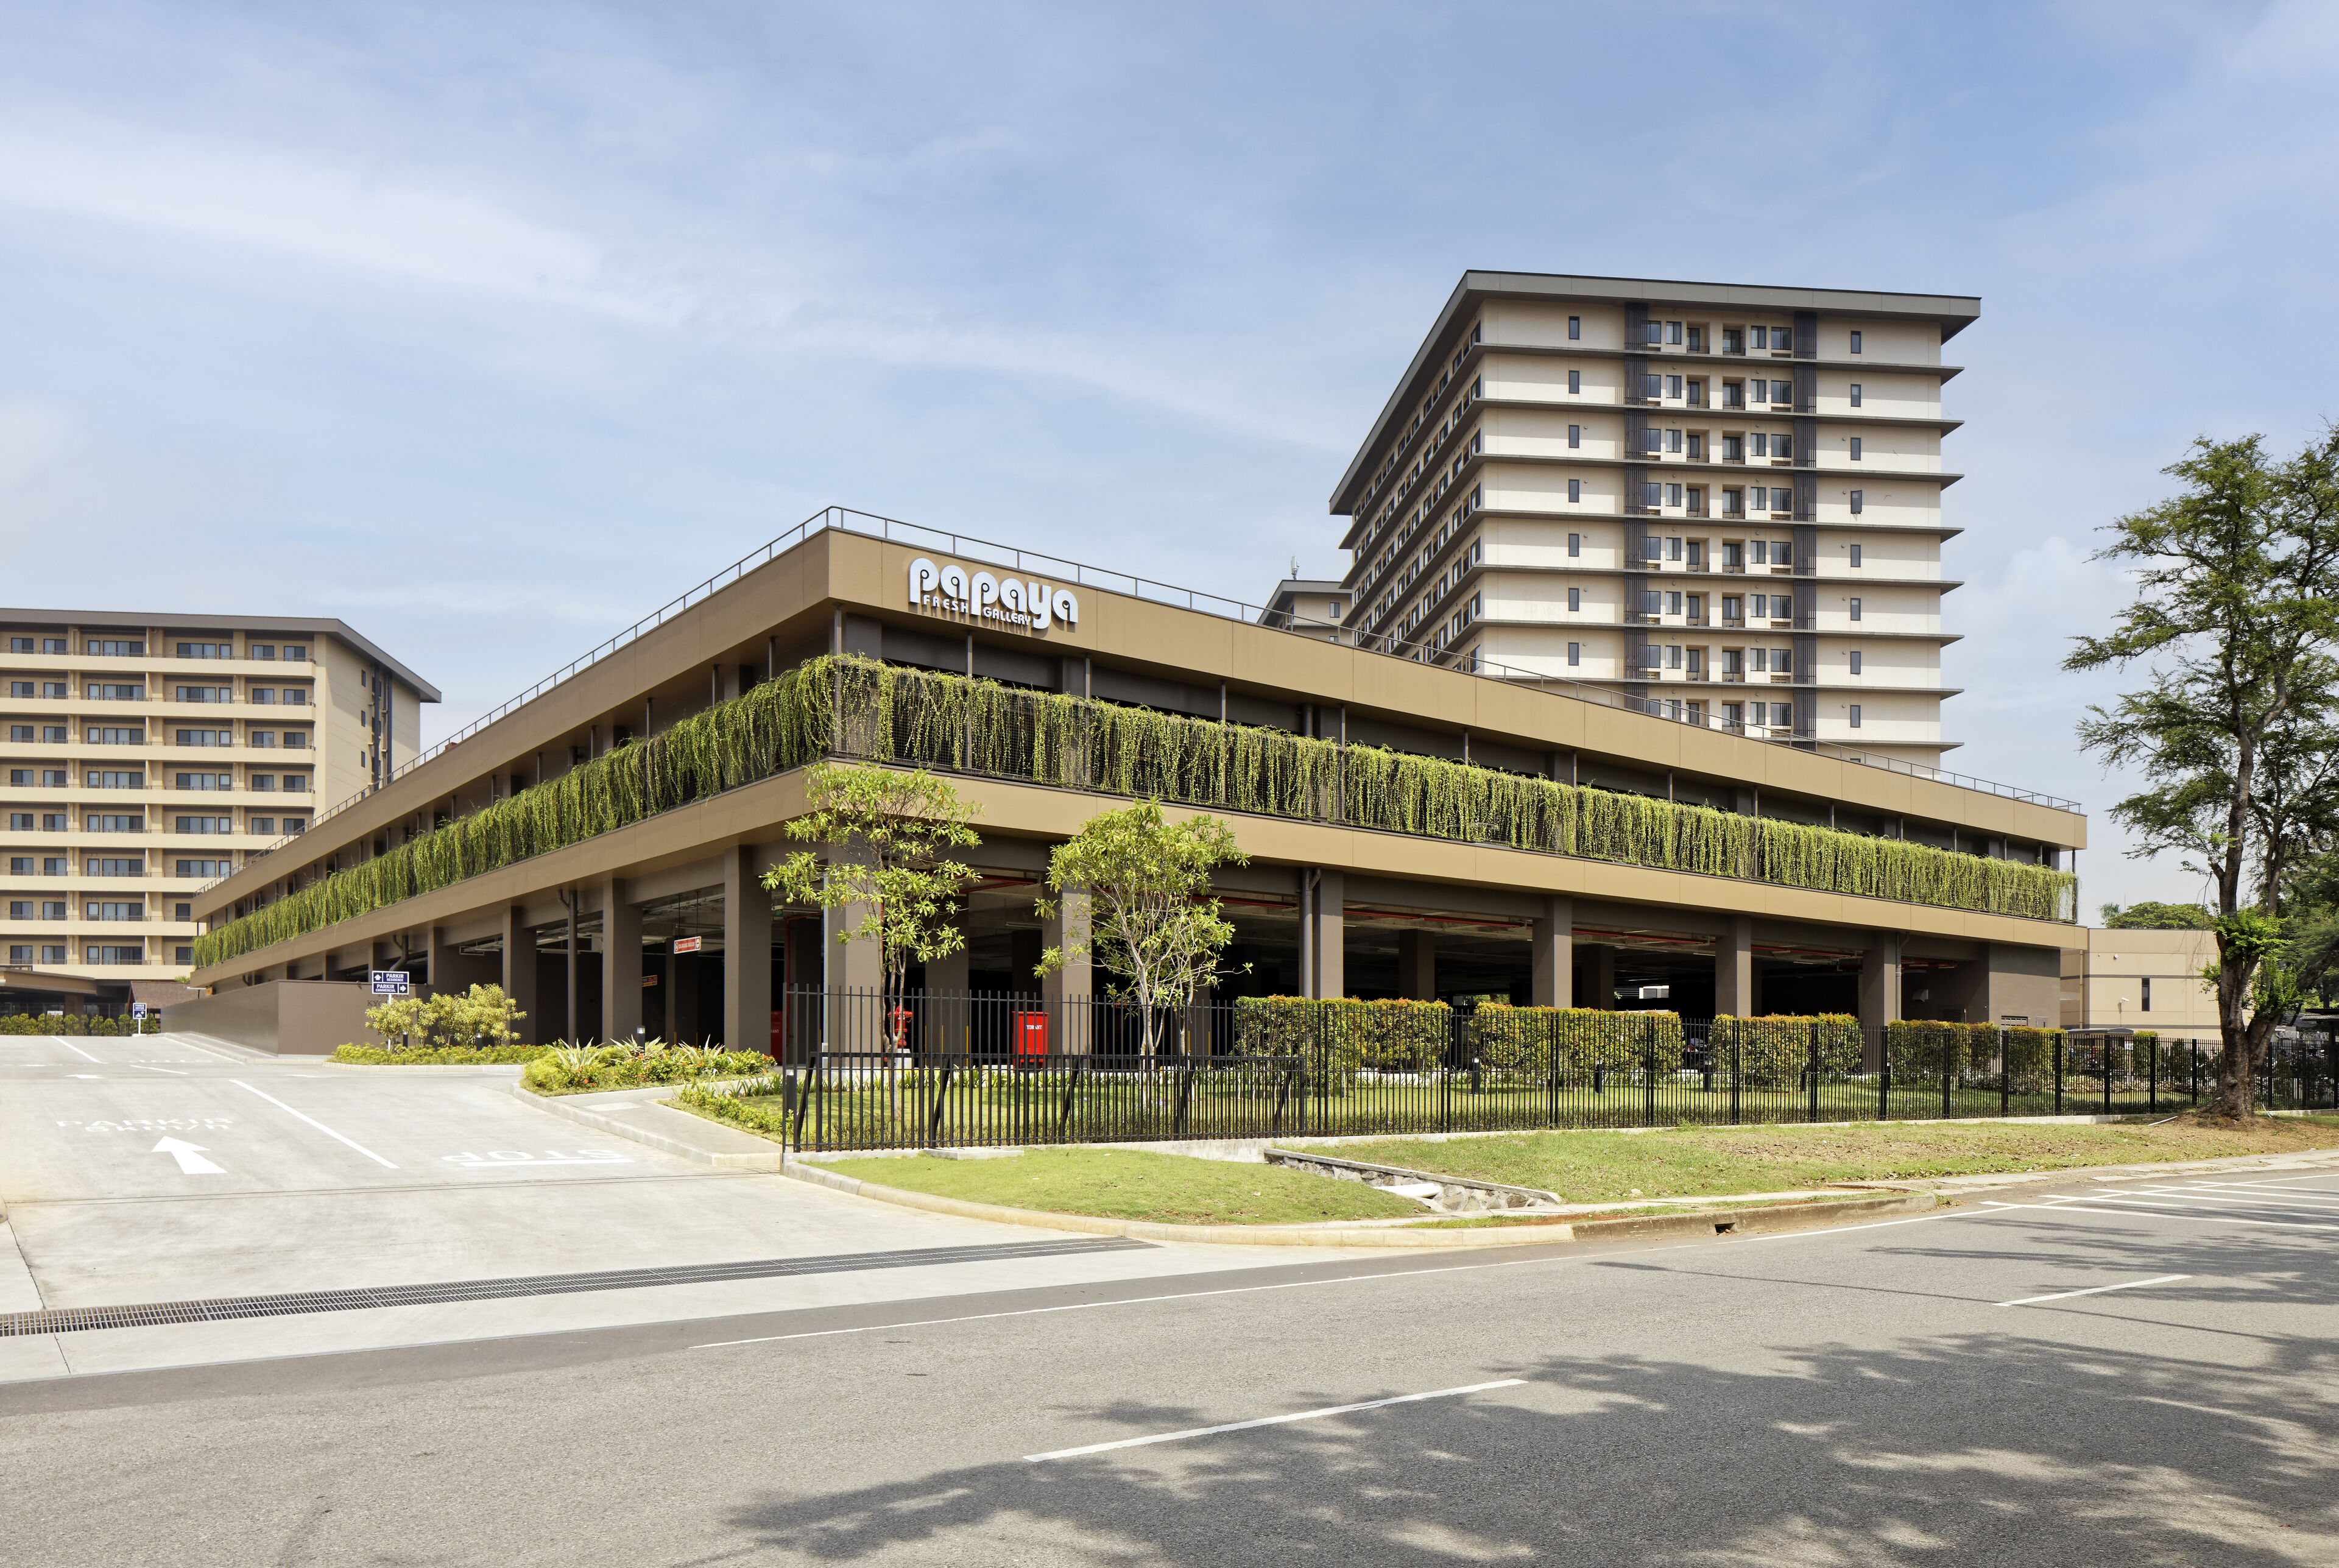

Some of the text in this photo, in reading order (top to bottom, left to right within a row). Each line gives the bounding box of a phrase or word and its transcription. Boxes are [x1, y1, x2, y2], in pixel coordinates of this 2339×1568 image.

[909, 557, 1078, 629] papaya
[923, 595, 1031, 625] FRESH GALLERY
[56, 1118, 234, 1127] PARKIR
[441, 1150, 624, 1162] STOP
